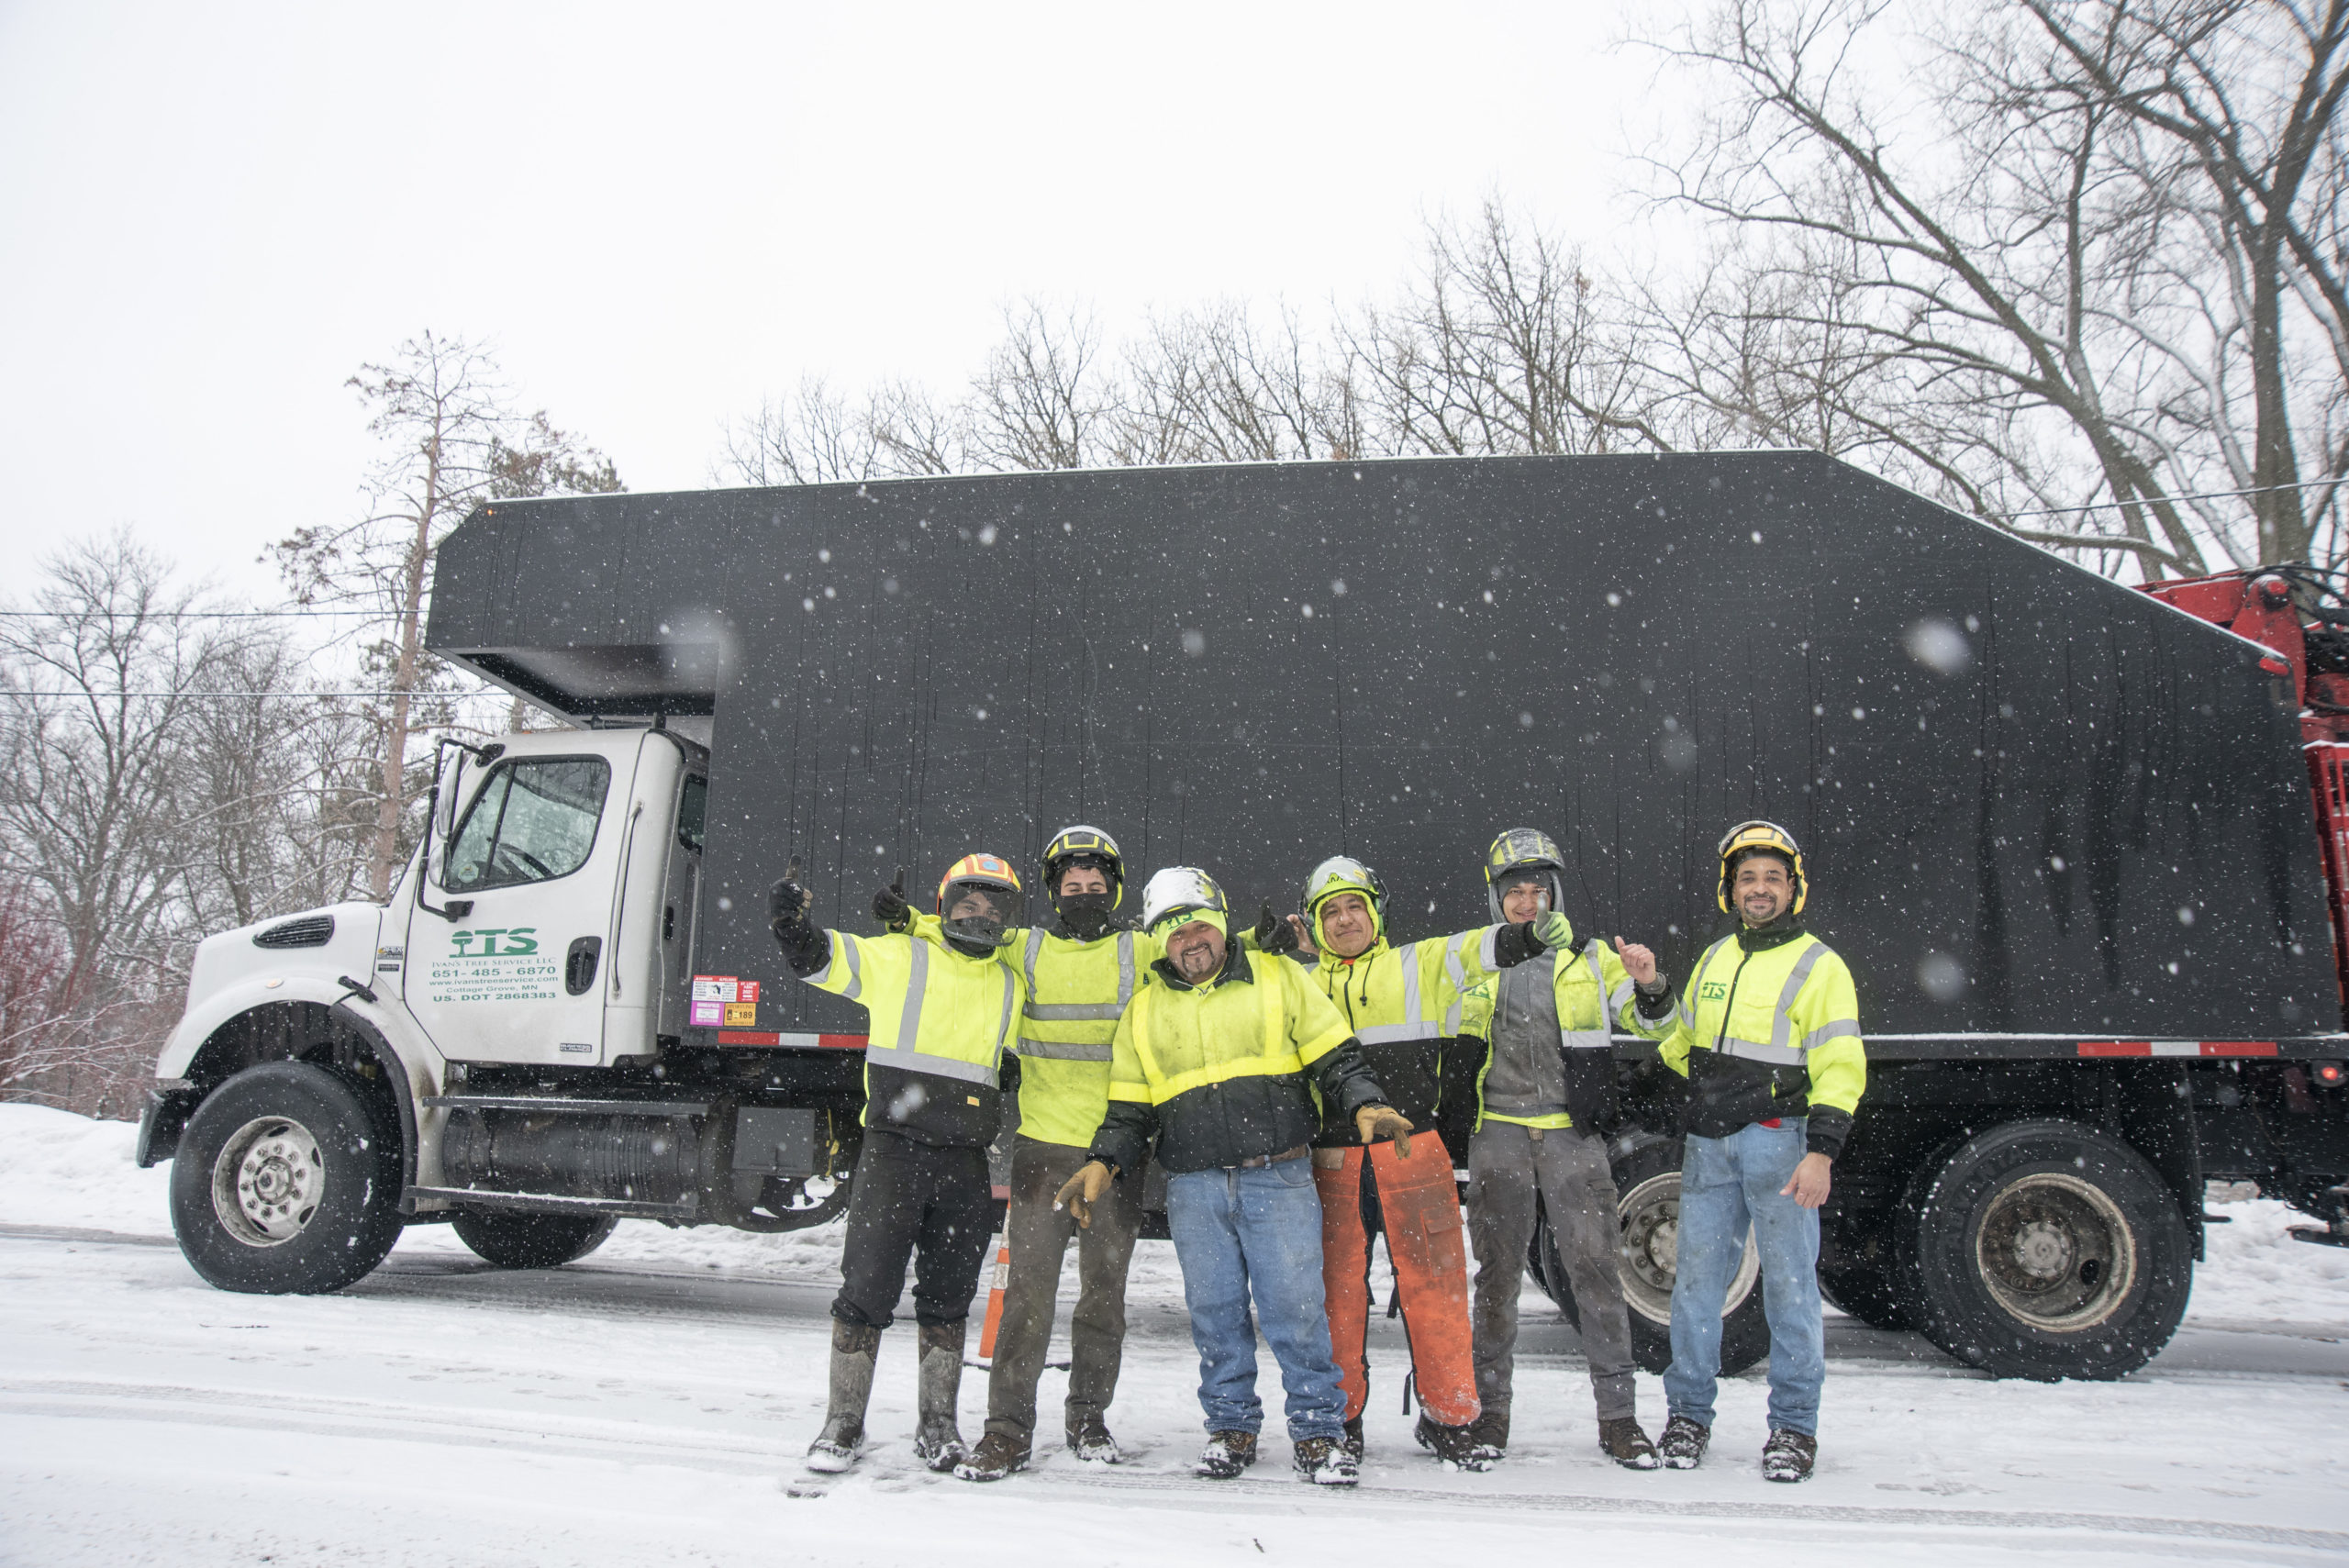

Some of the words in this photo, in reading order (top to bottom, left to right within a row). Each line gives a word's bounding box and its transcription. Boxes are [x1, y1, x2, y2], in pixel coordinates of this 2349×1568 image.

[465, 959, 487, 967] TREE
[492, 958, 533, 966] SERVICE
[471, 968, 500, 977] 485
[517, 966, 556, 975] 6870
[429, 976, 558, 986] www.ivanstreeservice.com
[495, 992, 556, 1000] 2868383
[739, 1011, 752, 1019] 189
